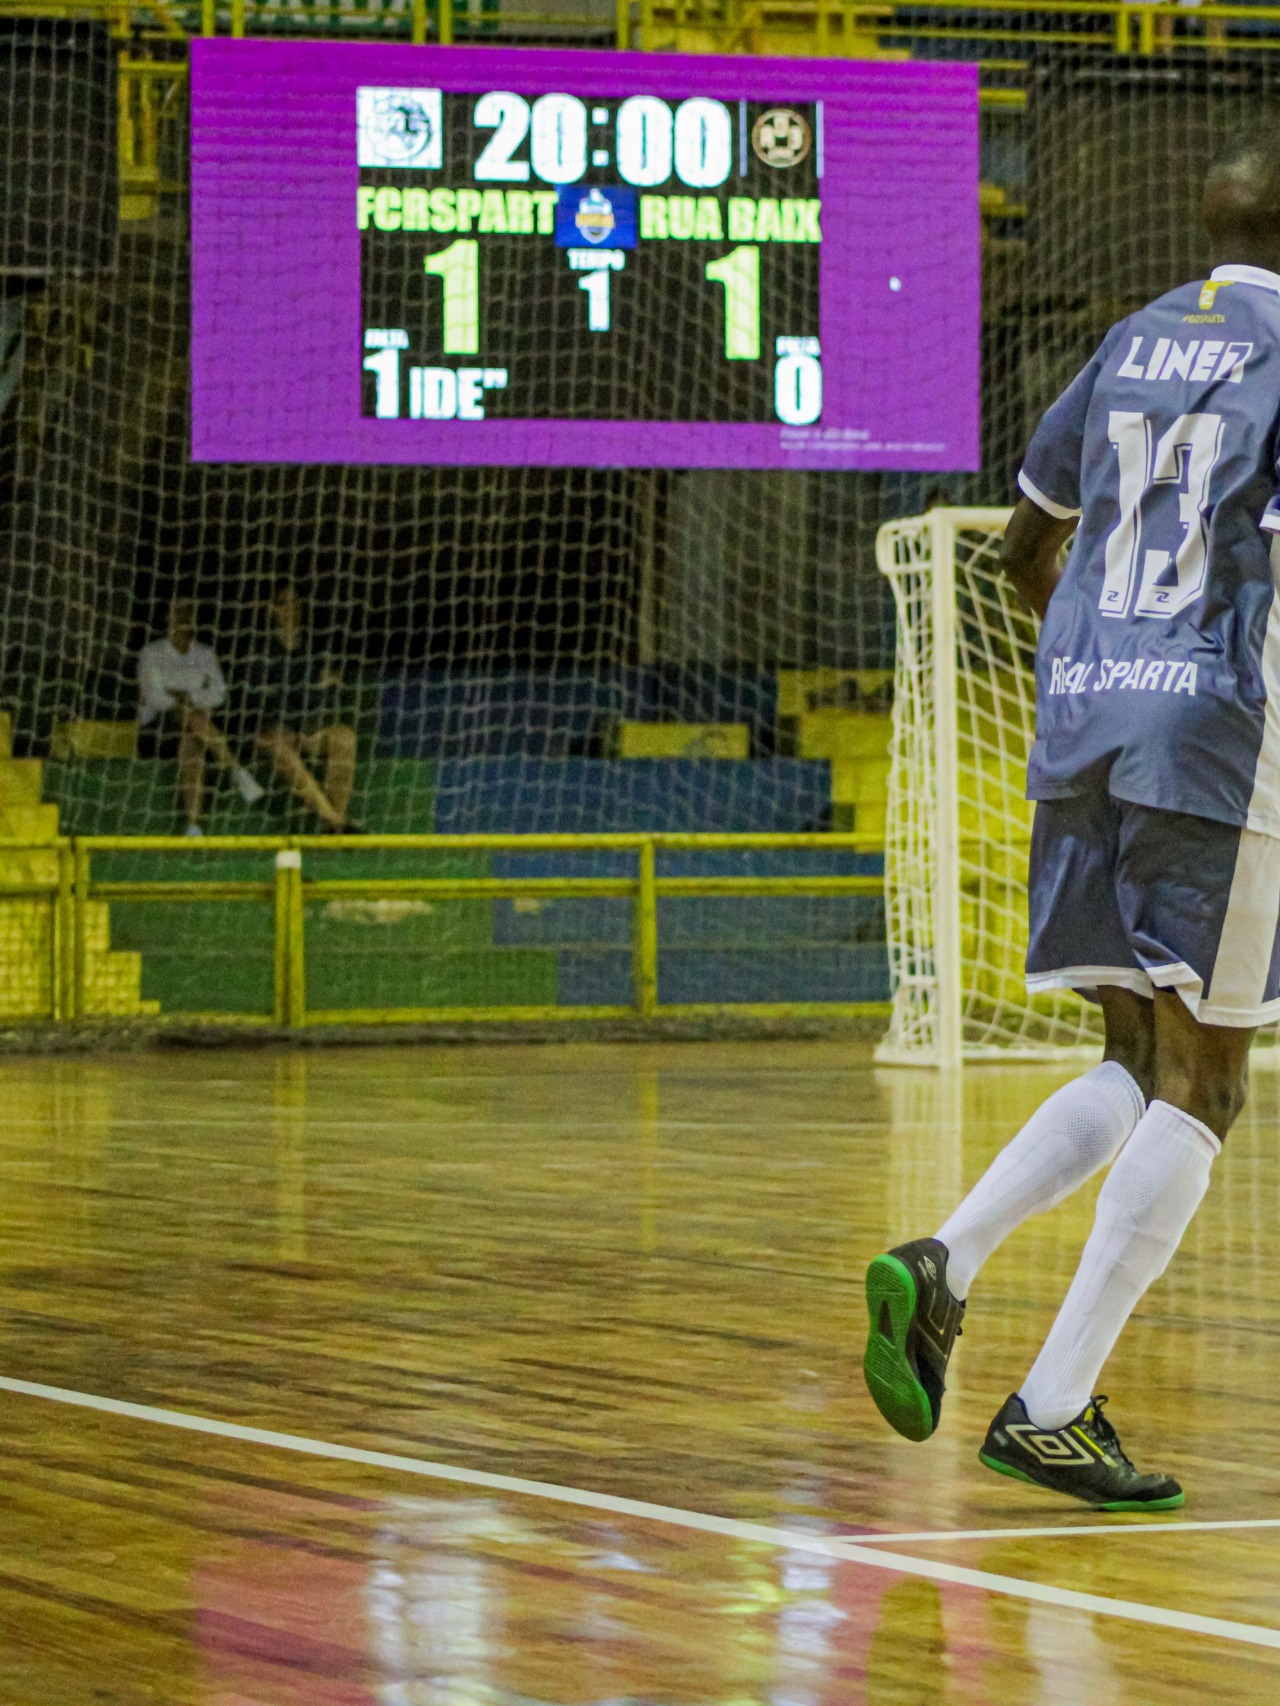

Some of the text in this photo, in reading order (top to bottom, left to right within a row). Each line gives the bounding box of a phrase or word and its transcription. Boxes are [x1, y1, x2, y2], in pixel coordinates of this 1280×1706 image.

[473, 91, 732, 188] 20:00
[356, 186, 559, 234] FCRSPART
[640, 195, 823, 243] RUA BAIX
[424, 239, 479, 354] 1
[578, 270, 610, 332] 1
[705, 245, 760, 360] 1
[363, 348, 399, 419] 1
[774, 355, 822, 427] 0
[1097, 411, 1226, 620] 13
[1048, 656, 1198, 697] REAL SPARTA
